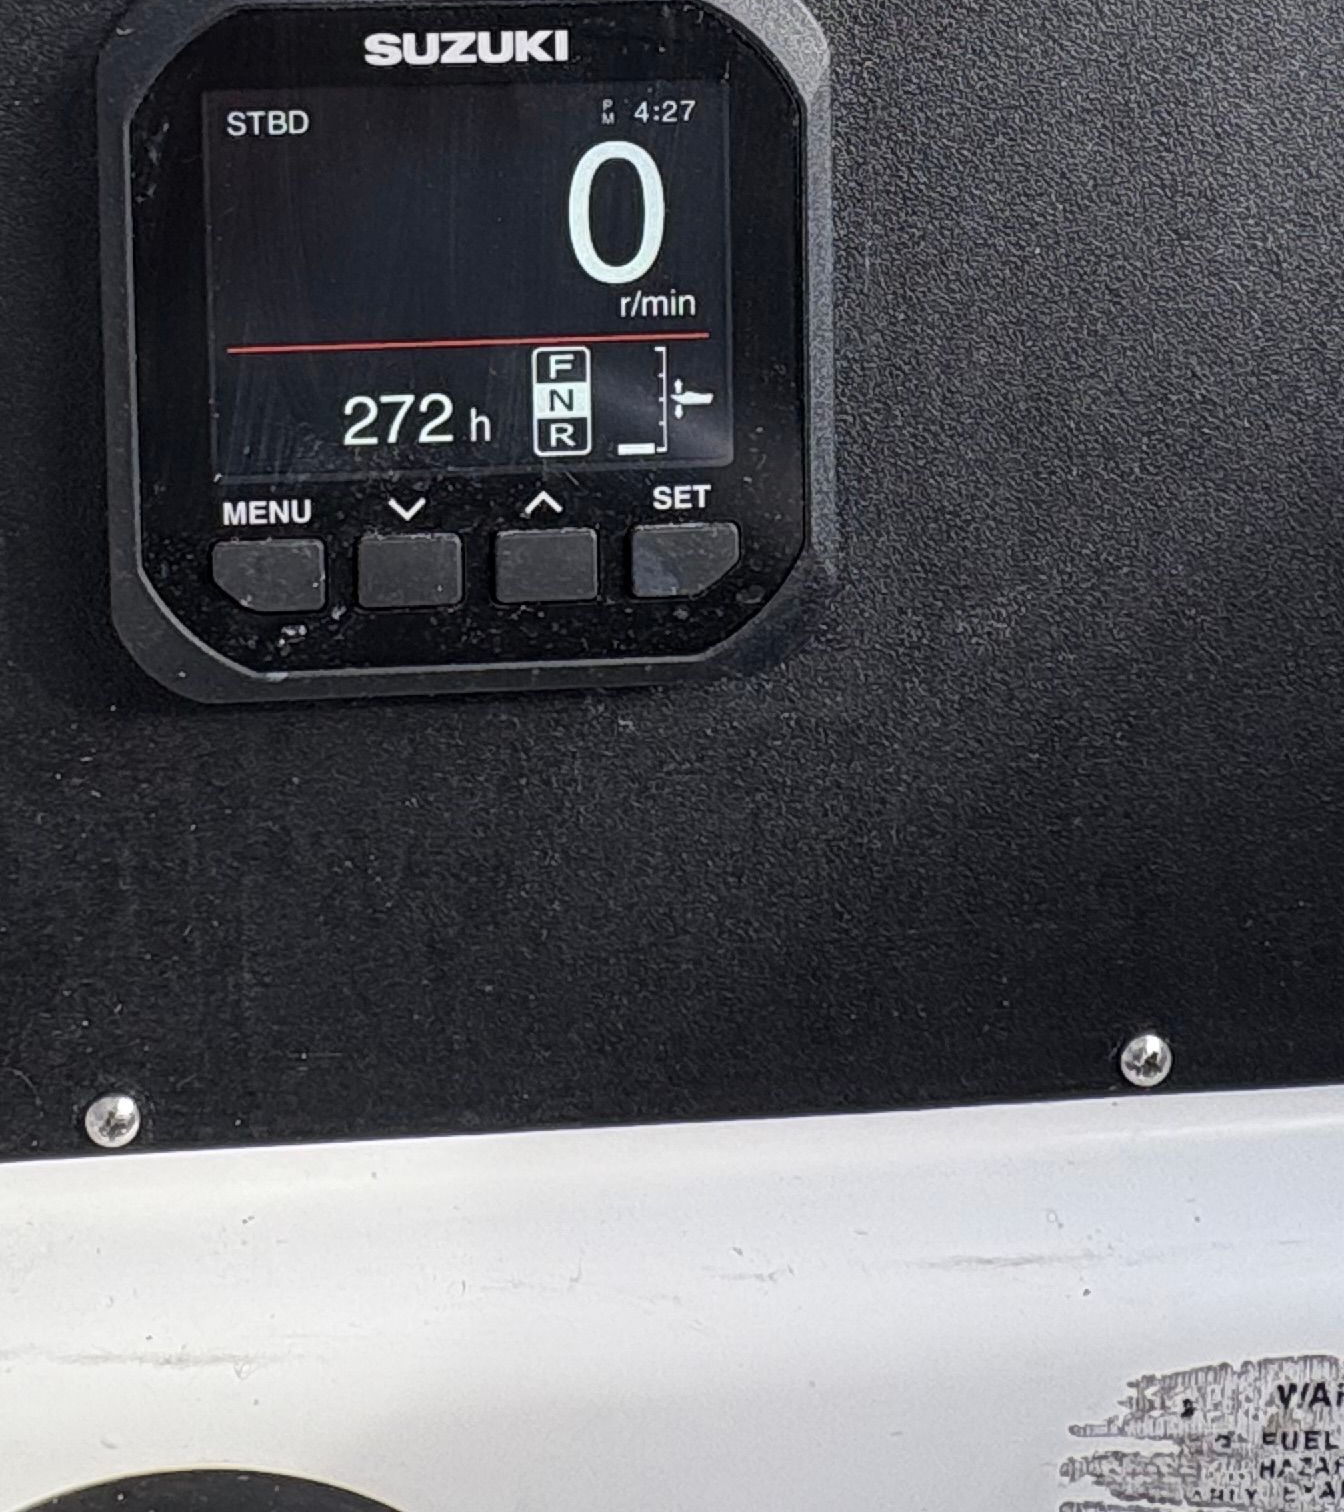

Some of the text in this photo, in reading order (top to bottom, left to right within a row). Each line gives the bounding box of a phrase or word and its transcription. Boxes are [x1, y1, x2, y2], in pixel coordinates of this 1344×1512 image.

[364, 30, 569, 66] SUZUKI
[226, 110, 310, 137] STBD
[634, 100, 696, 124] 4:27
[568, 140, 666, 285] 0
[619, 290, 696, 318] r/min
[549, 354, 575, 379] F
[550, 389, 574, 412] N
[343, 393, 492, 446] 272 h
[551, 423, 576, 447] R
[653, 485, 712, 510] SET
[223, 500, 312, 525] MENU
[1262, 1430, 1339, 1450] FUEL
